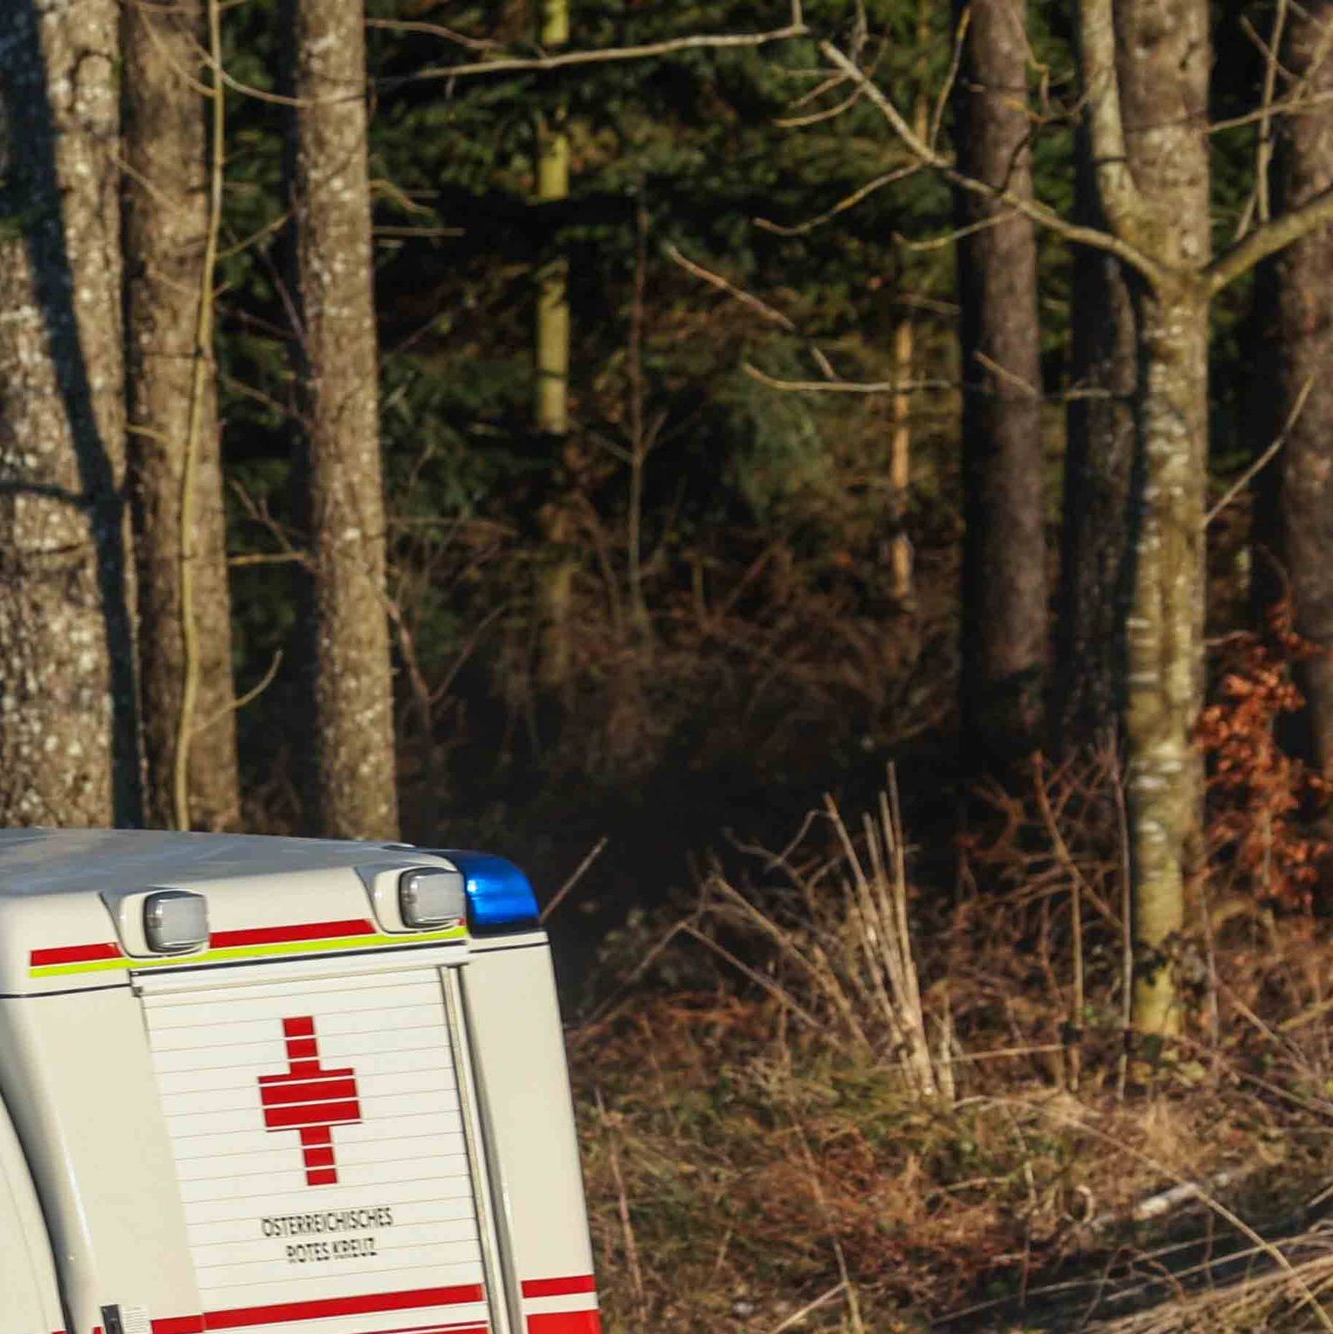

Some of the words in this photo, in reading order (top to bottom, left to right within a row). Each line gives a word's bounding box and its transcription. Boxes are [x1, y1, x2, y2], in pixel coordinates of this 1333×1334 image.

[261, 1207, 393, 1237] ÖSTERREICHISCHES
[286, 1240, 330, 1263] ROTES
[332, 1237, 378, 1260] KREUZ
